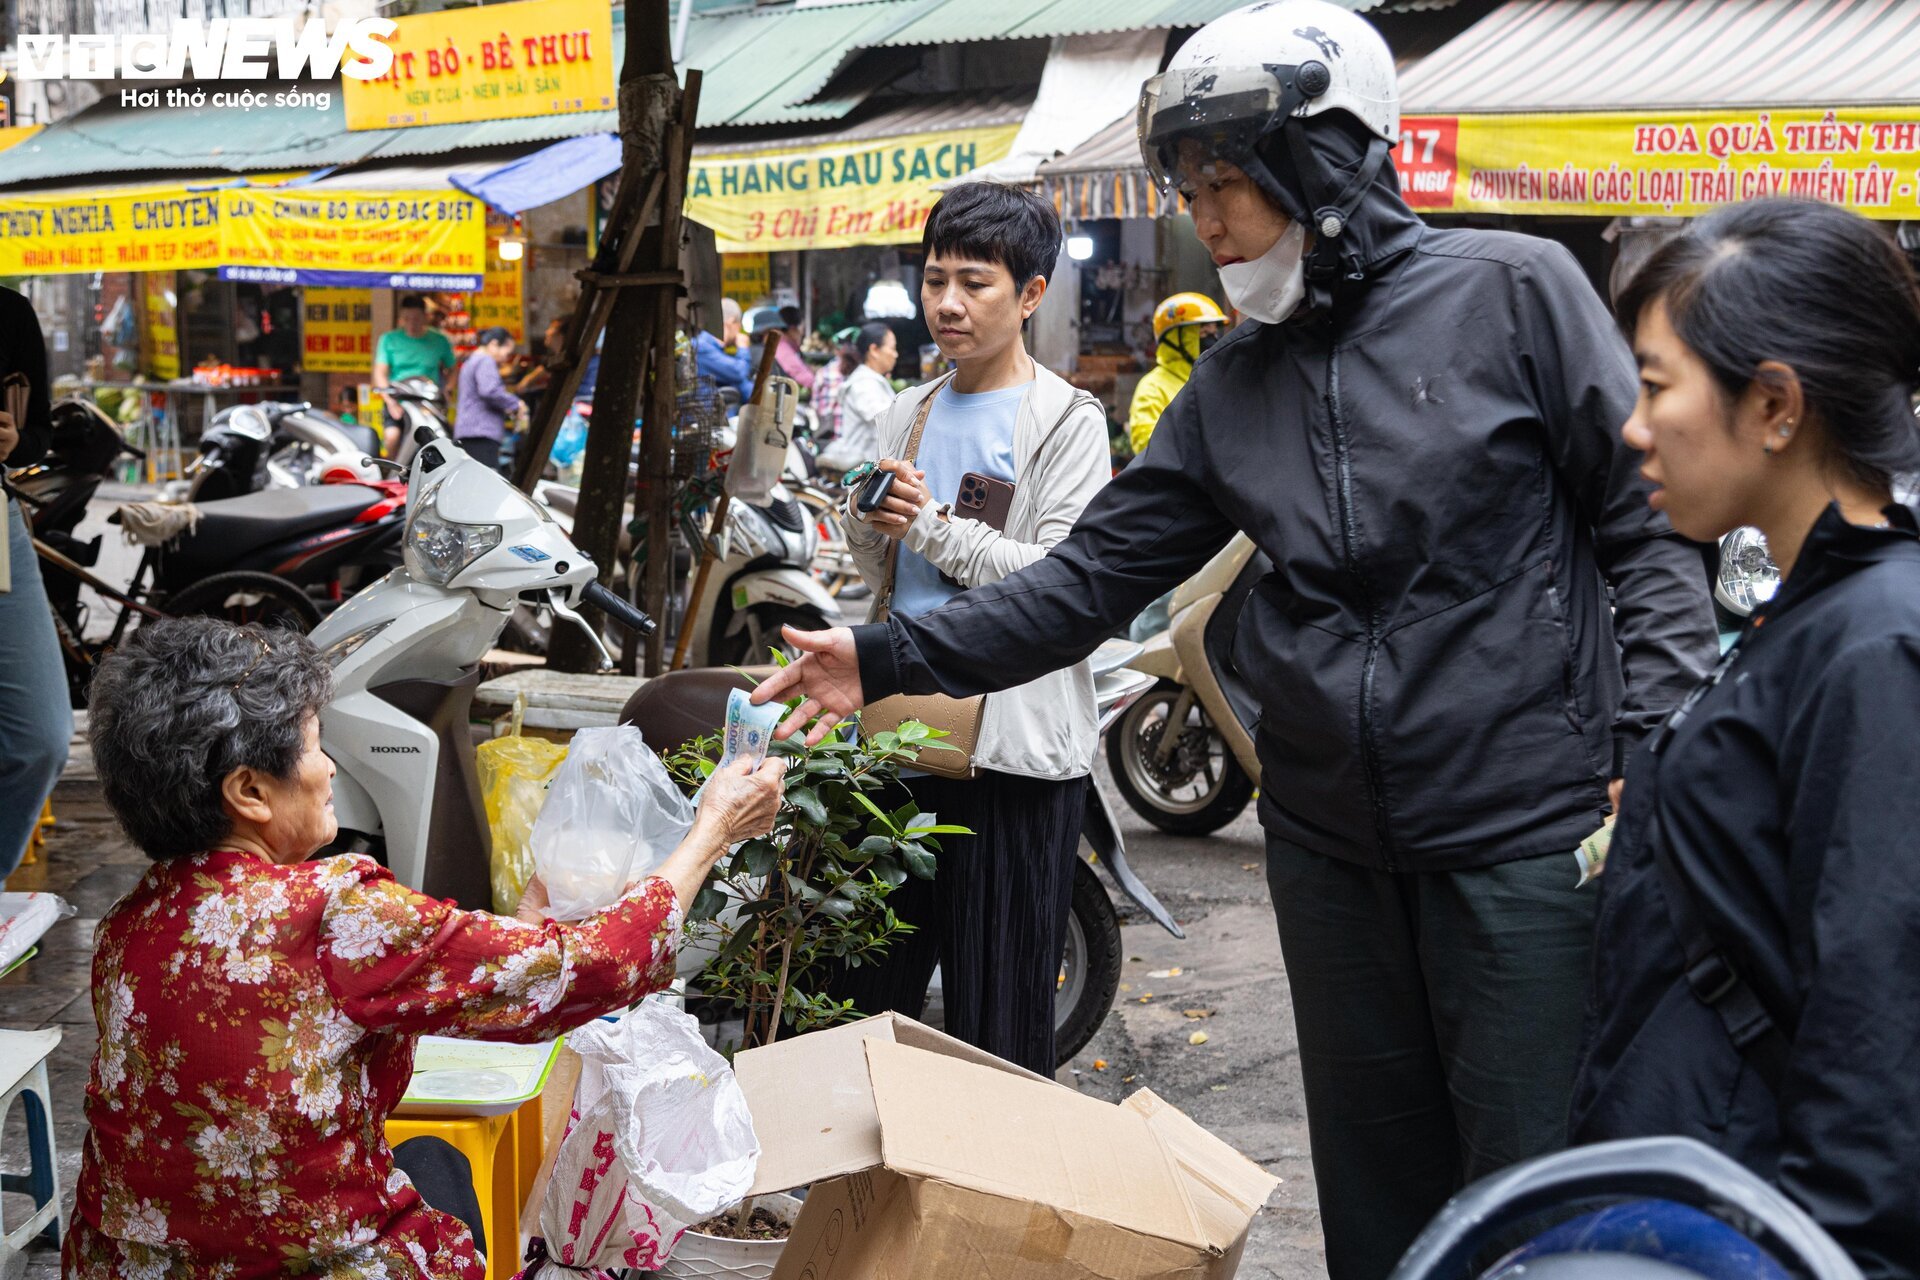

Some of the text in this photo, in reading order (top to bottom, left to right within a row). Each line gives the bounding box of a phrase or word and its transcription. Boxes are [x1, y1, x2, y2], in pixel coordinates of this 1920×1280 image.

[425, 36, 460, 78] BÒ
[481, 31, 514, 70] BÊ
[522, 31, 592, 67] THUI
[1400, 129, 1441, 164] 17
[1634, 111, 1920, 158] HOA QUẢ TIỀN TH
[818, 151, 882, 188] RAU
[892, 142, 976, 186] SẠCH
[1413, 168, 1452, 192] NGƯ
[1470, 164, 1542, 202] CHUYÊN
[1549, 163, 1586, 202] BÁN
[1593, 163, 1632, 202] CÁC
[1638, 170, 1683, 210] LOẠI
[1690, 162, 1735, 203] TRÁI
[1742, 165, 1783, 202] CÂY
[1854, 163, 1894, 204] TÂY
[745, 211, 765, 241] 3
[772, 206, 819, 246] Chị
[825, 205, 873, 236] Em
